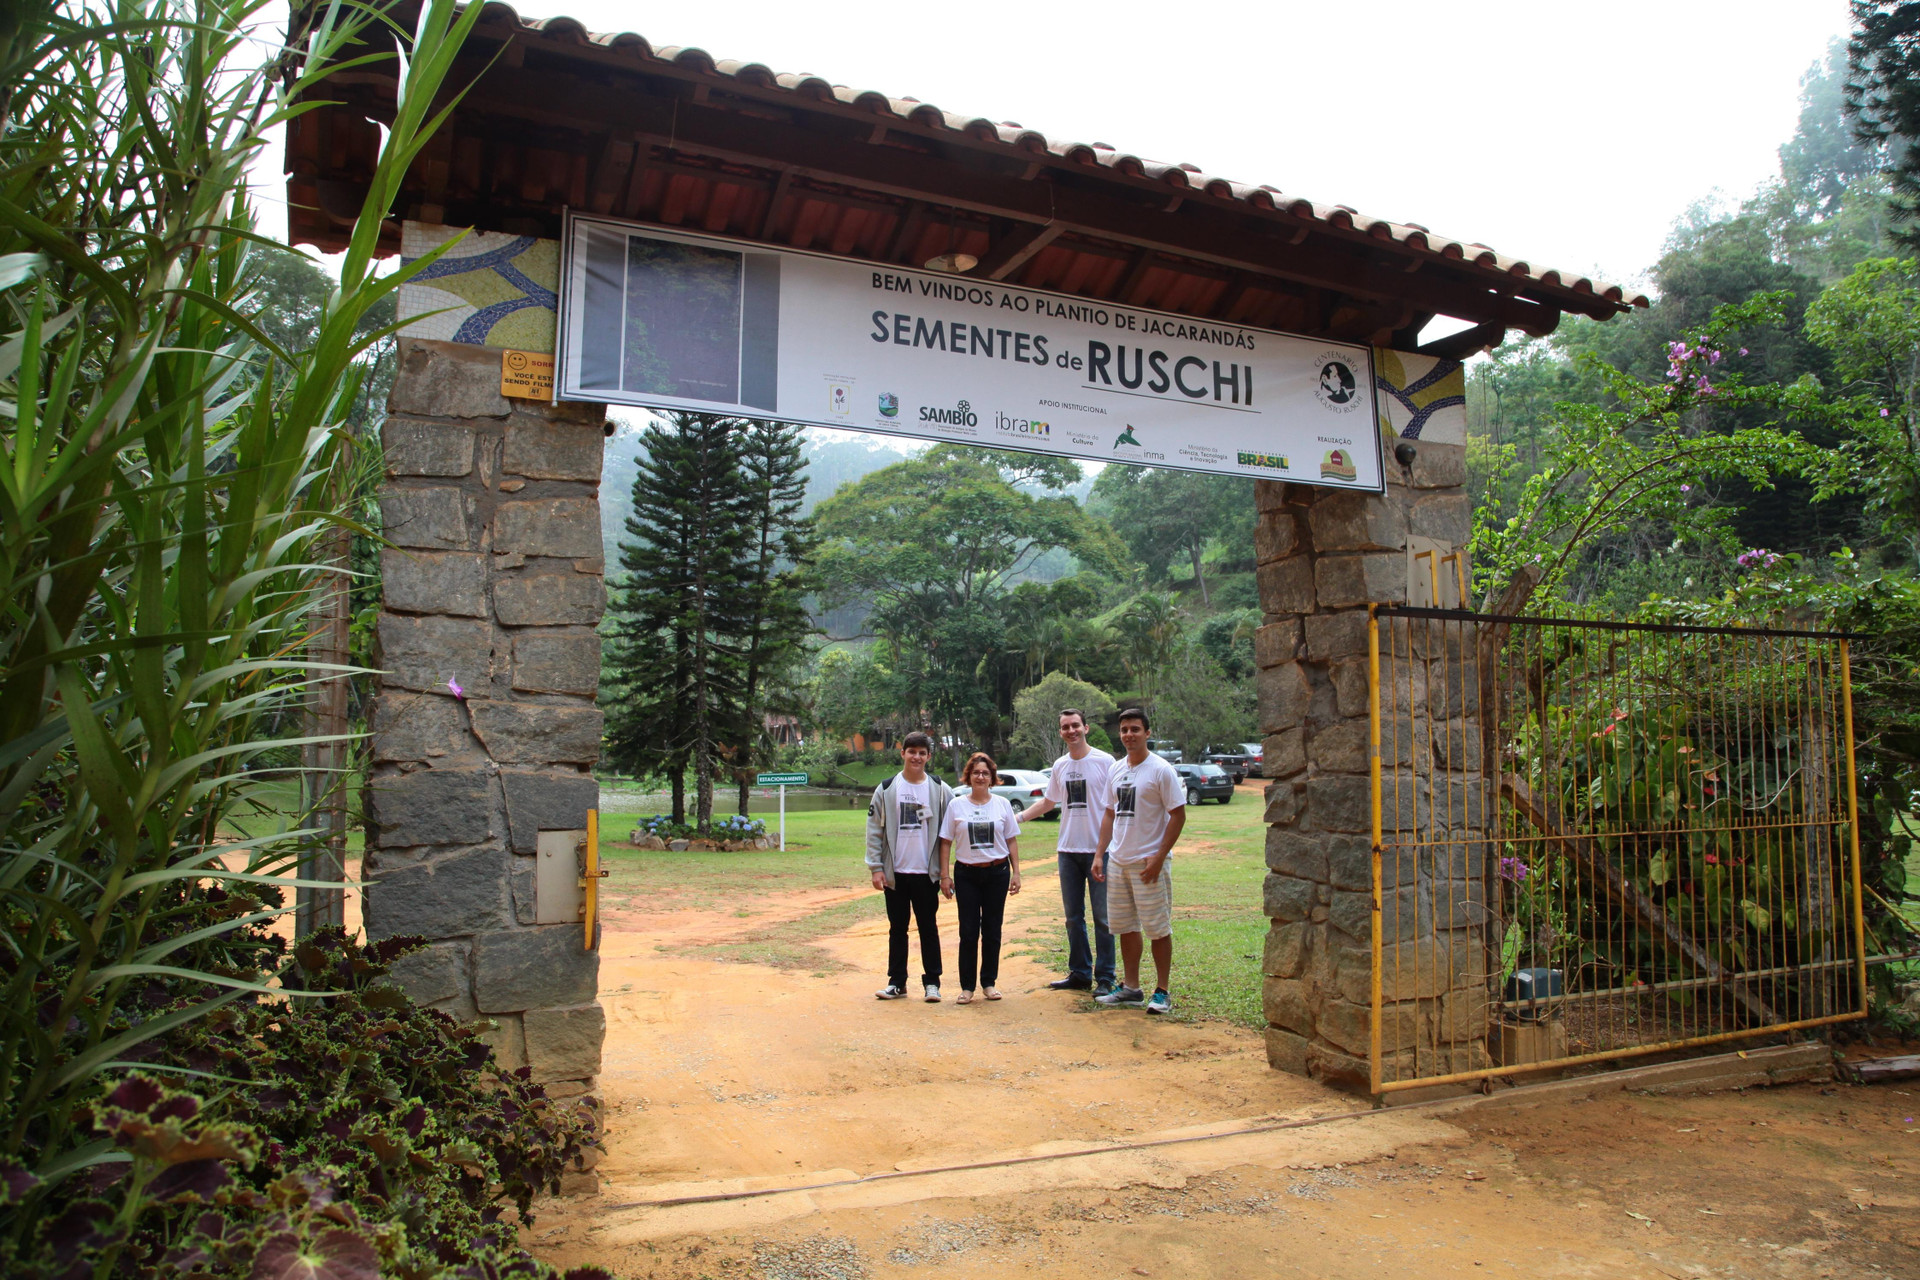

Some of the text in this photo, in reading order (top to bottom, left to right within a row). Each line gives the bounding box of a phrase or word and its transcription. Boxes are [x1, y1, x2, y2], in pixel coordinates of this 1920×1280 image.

[872, 272, 1255, 351] BEM VINDOS AO PLANTIO DE JACARANDÁS
[870, 310, 1252, 406] SEMENTES de RUSCHI
[504, 378, 530, 386] SENDO
[1039, 399, 1108, 415] APOIO INSTITUCIONAL
[1313, 390, 1342, 414] AUGUSTO
[995, 411, 1050, 435] ibram
[1143, 449, 1165, 460] inma
[1237, 452, 1289, 470] BRASIL
[759, 775, 806, 783] ESTACIONAMENTO
